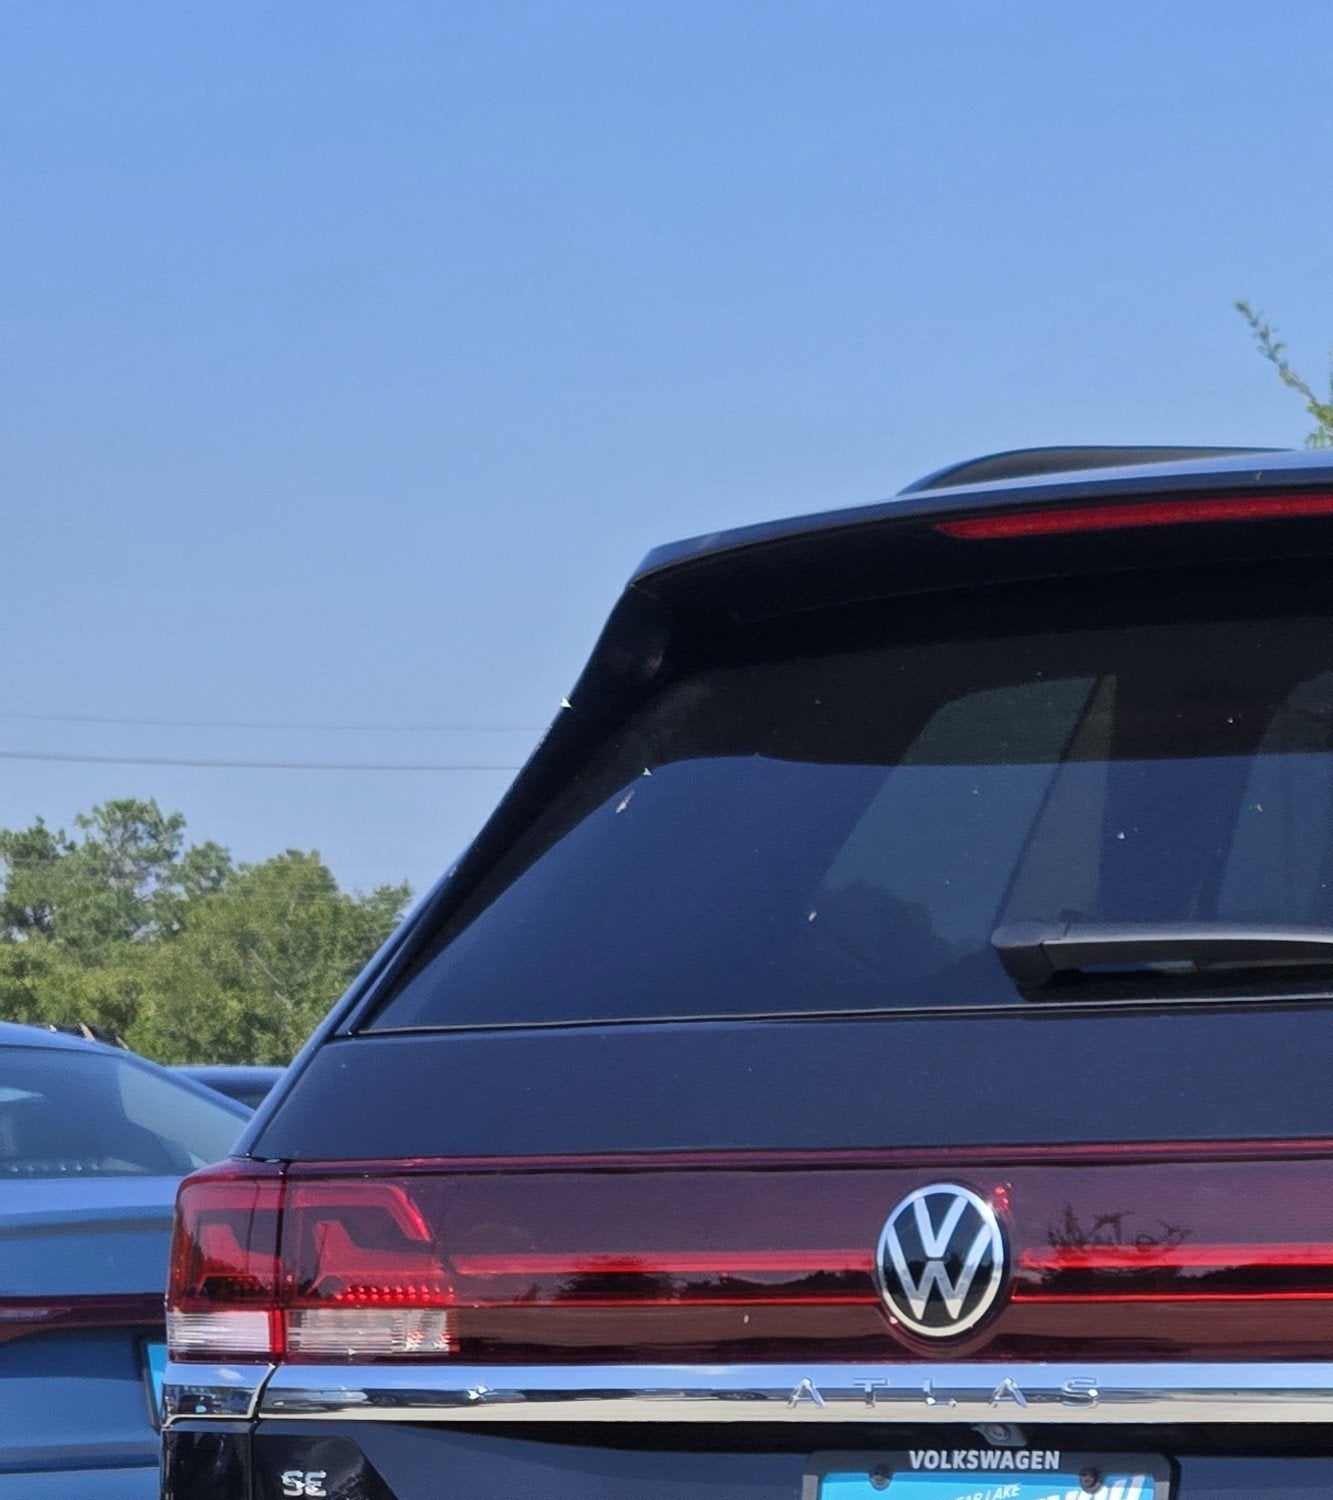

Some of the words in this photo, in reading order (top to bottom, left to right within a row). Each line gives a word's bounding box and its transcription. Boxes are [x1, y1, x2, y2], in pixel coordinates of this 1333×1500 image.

[785, 1377, 1100, 1409] ATLAS
[908, 1449, 1060, 1471] VOLKSWAGEN
[281, 1470, 327, 1497] SE
